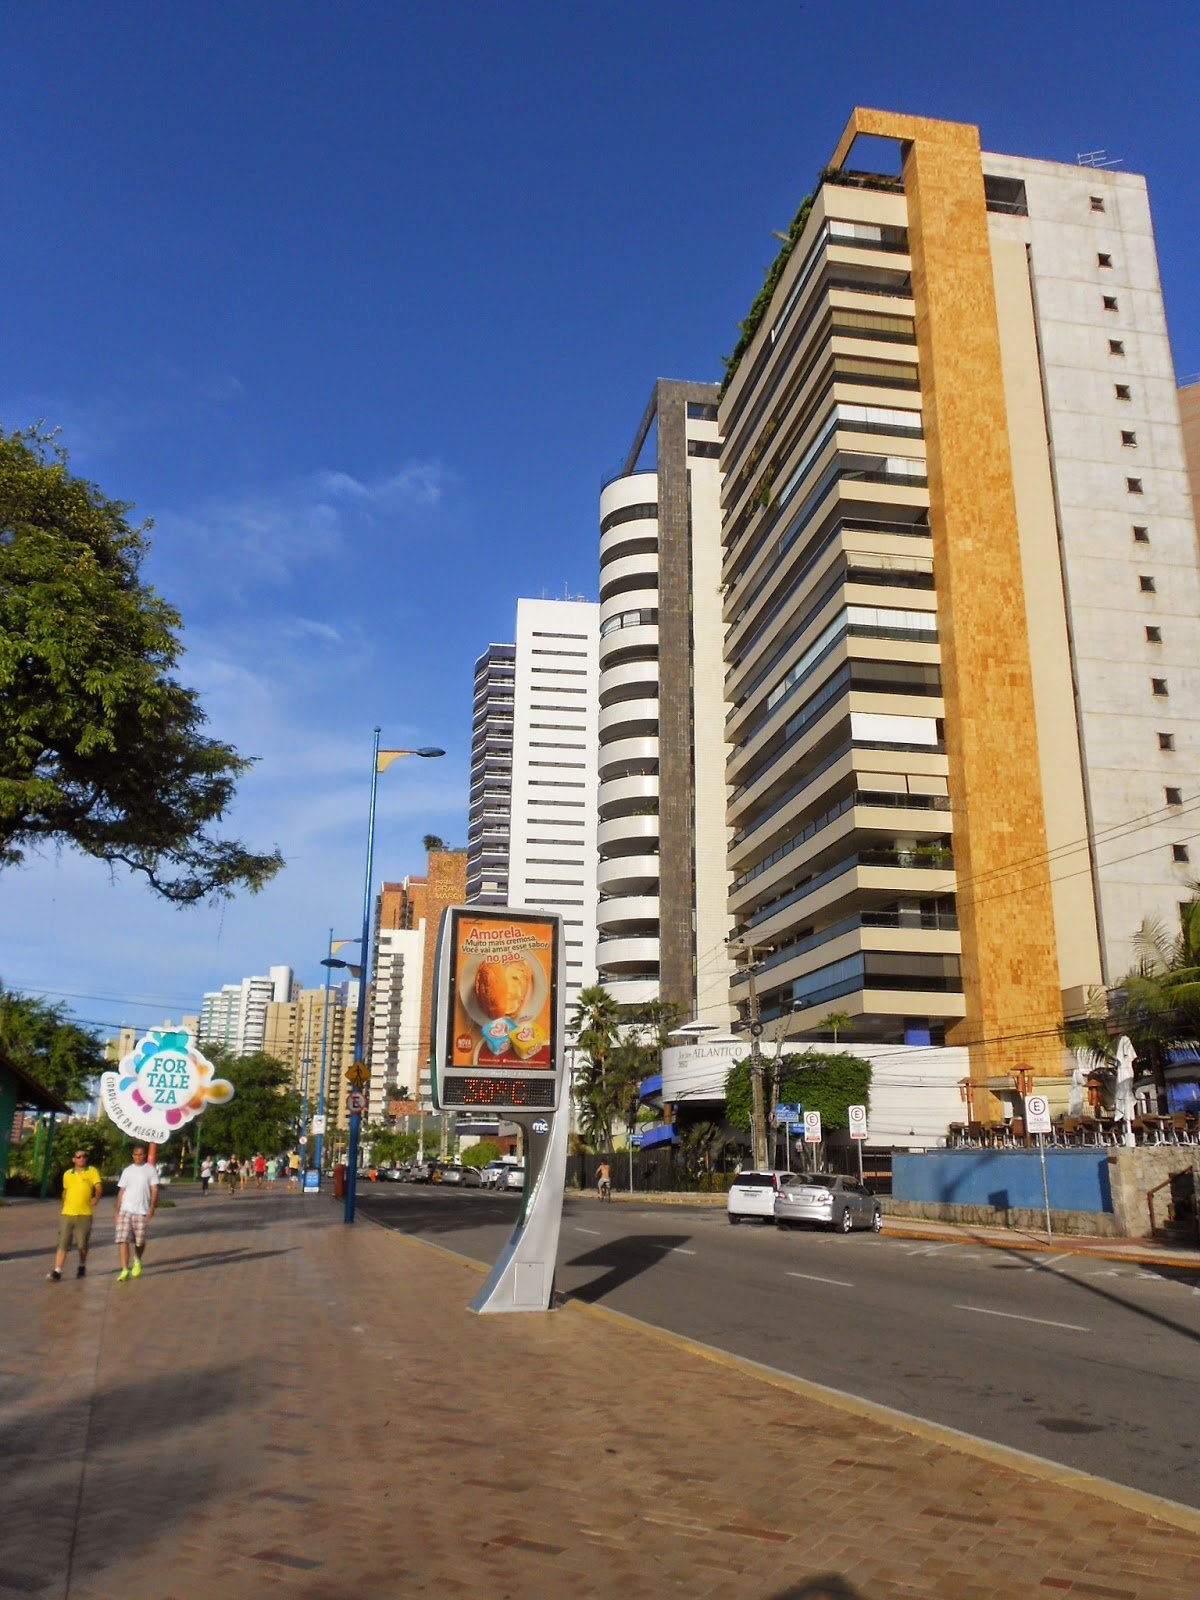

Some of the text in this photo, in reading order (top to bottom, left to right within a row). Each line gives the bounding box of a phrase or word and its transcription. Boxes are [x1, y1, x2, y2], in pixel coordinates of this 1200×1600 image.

[469, 926, 525, 939] Amorela.
[465, 935, 537, 947] Muito mais cremosa.
[461, 945, 479, 953] Você
[480, 945, 491, 953] vai
[491, 945, 510, 953] amar
[512, 943, 527, 951] esse
[486, 954, 500, 962] no
[152, 1058, 187, 1073] FOR
[147, 1073, 190, 1089] TALE
[154, 1089, 177, 1104] ZA
[1033, 1101, 1041, 1111] E
[809, 1115, 815, 1123] E
[854, 1110, 860, 1118] E
[123, 1118, 131, 1128] DA
[133, 1126, 164, 1139] ALEGRIA
